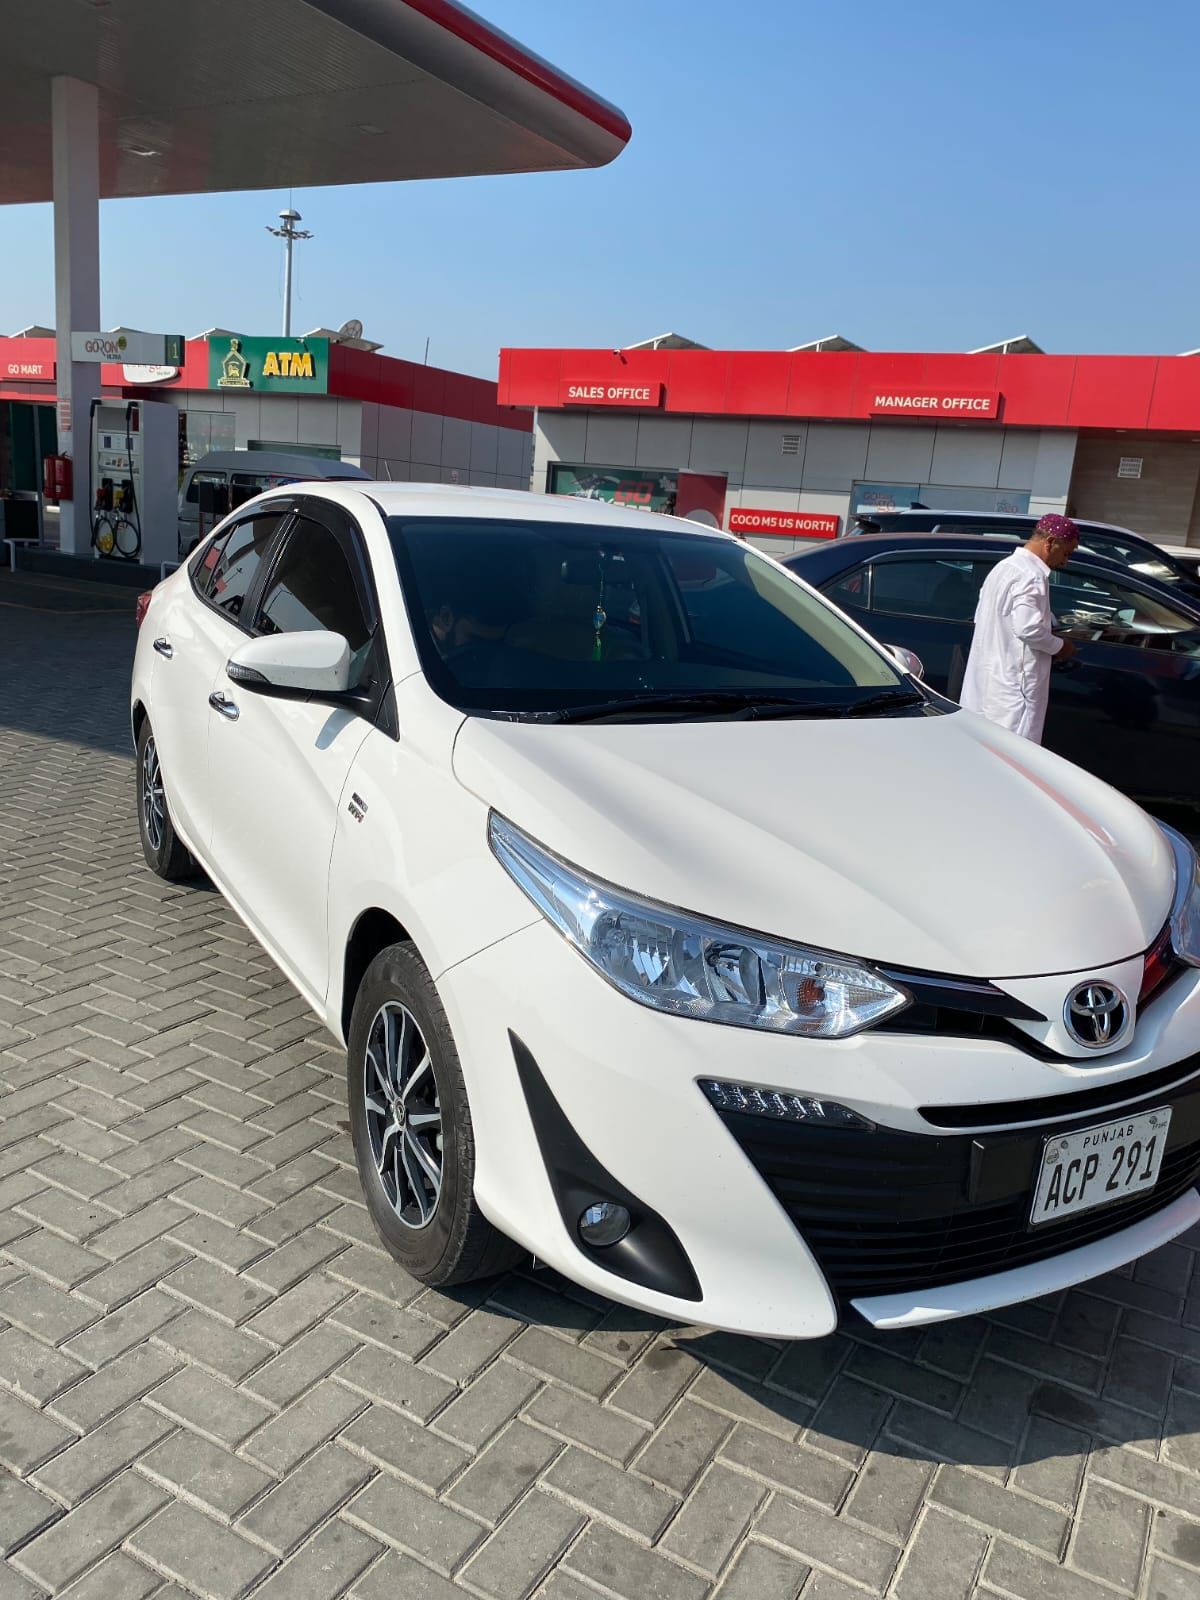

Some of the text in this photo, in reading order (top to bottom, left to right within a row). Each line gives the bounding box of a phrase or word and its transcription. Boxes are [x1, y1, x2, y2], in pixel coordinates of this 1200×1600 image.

[8, 364, 43, 375] GO MART
[262, 351, 313, 377] ATM
[568, 386, 650, 401] SALES OFFICE
[874, 395, 991, 411] MANAGER OFFICE
[615, 480, 655, 504] GO
[731, 513, 835, 532] COCO M5 US NORTH
[1083, 1124, 1134, 1149] PUNJAB
[1044, 1135, 1157, 1211] ACP 291
